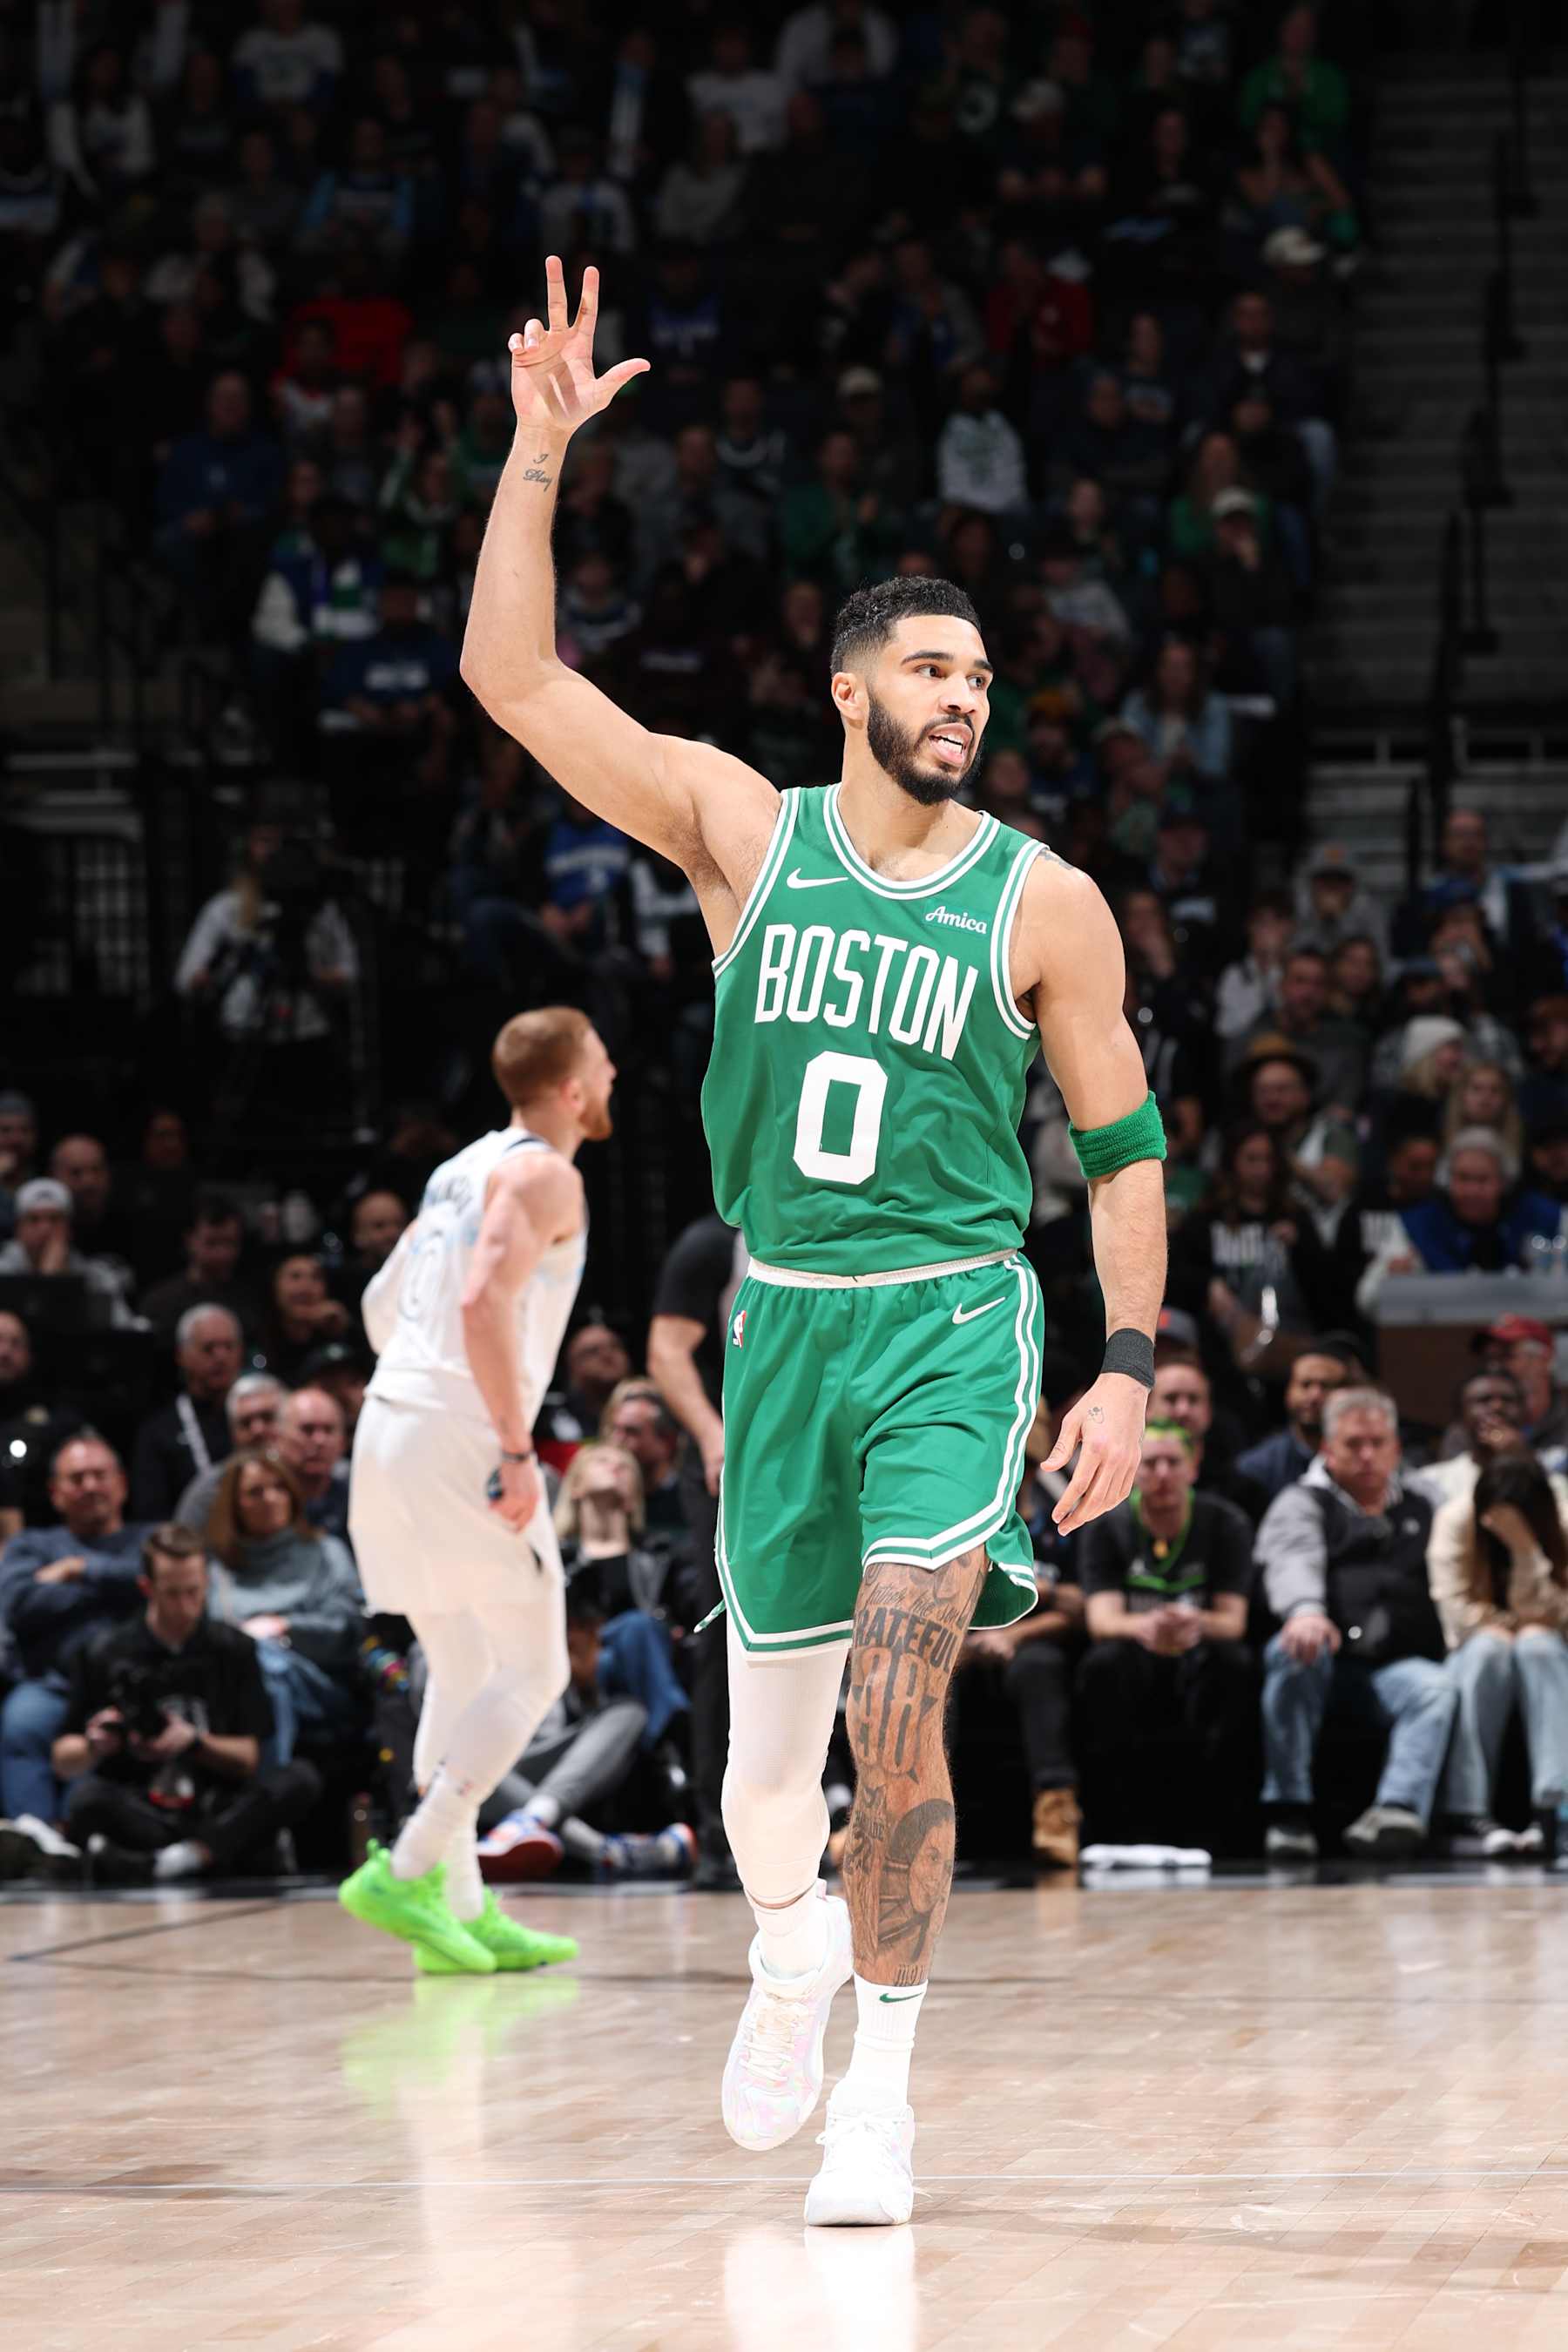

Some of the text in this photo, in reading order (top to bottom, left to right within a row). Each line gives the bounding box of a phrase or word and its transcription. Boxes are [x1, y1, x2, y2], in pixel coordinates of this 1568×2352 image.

[925, 905, 987, 935] Amica
[754, 923, 979, 1061] BOSTON
[794, 1051, 889, 1185] 0
